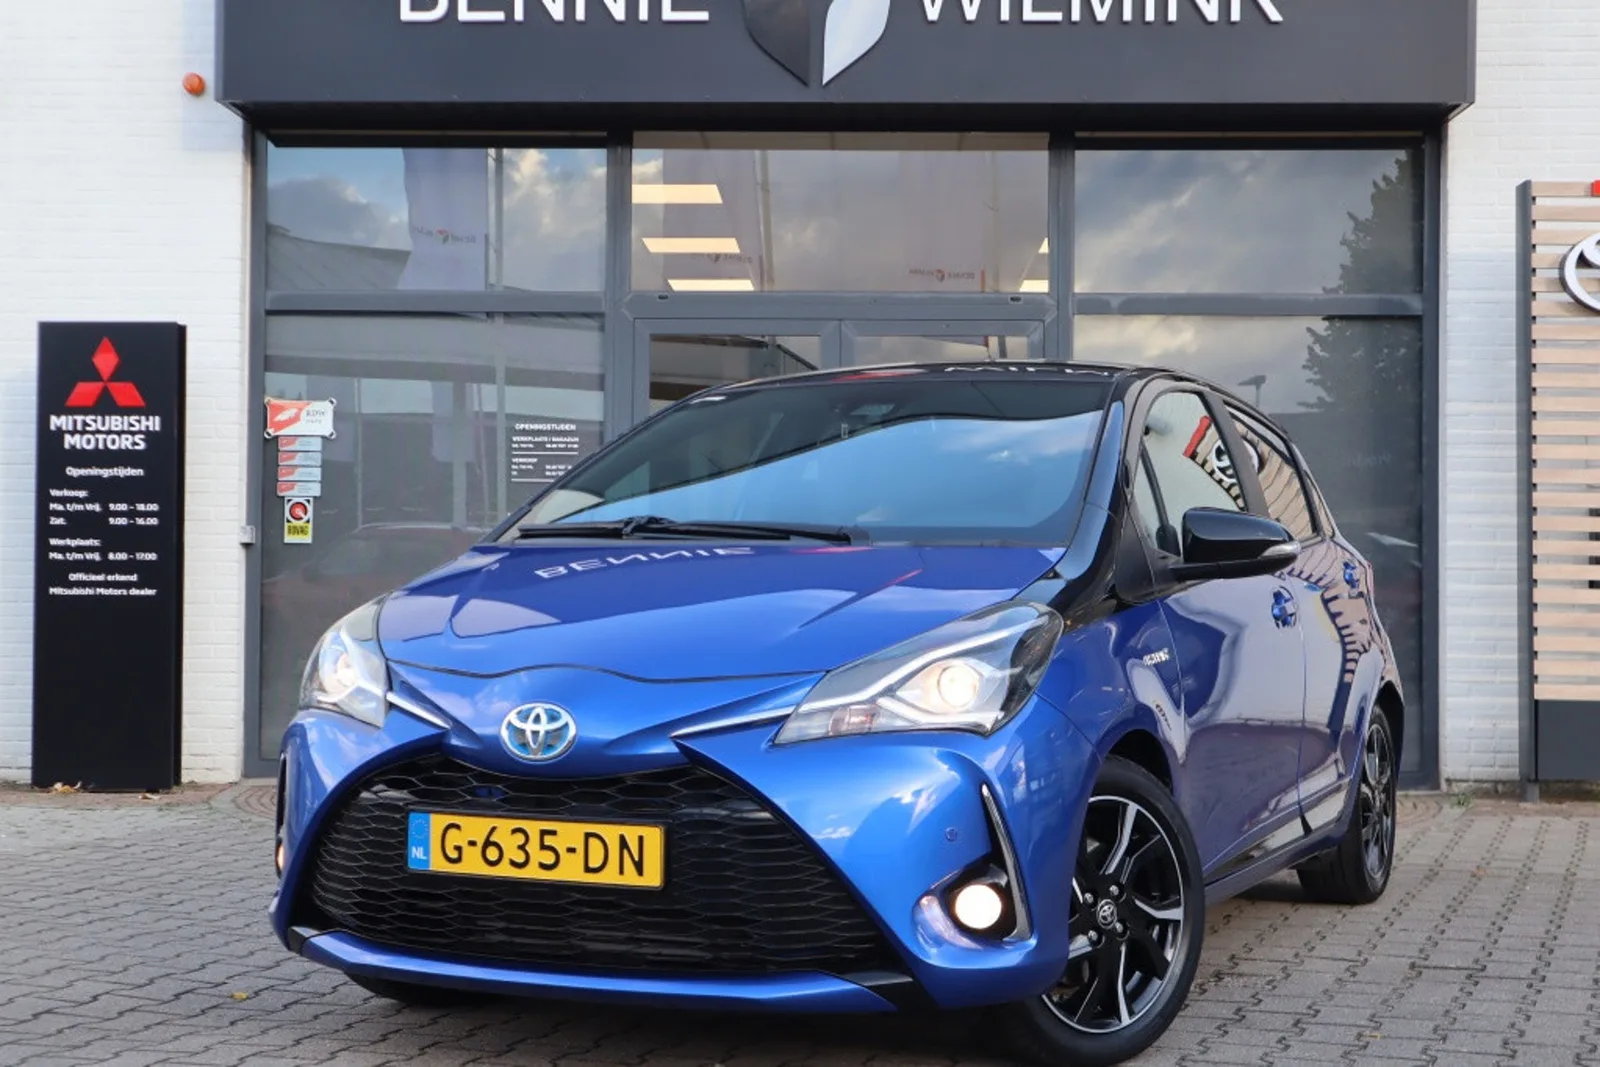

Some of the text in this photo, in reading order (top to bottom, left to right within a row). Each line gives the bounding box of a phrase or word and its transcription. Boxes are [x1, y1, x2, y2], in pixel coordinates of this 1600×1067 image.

[49, 414, 161, 431] MITSUBISHI
[64, 433, 147, 450] MOTORS
[65, 466, 144, 478] Openingstijden
[49, 488, 89, 498] Verkoop:
[66, 503, 84, 512] t/m
[109, 503, 128, 511] 9.00
[109, 517, 128, 525] 9.00
[66, 552, 84, 561] t/m
[68, 572, 138, 581] Officieel erkend
[49, 587, 157, 595] Mitsubishi Motors dealer
[411, 821, 645, 877] NL G-635-DN
